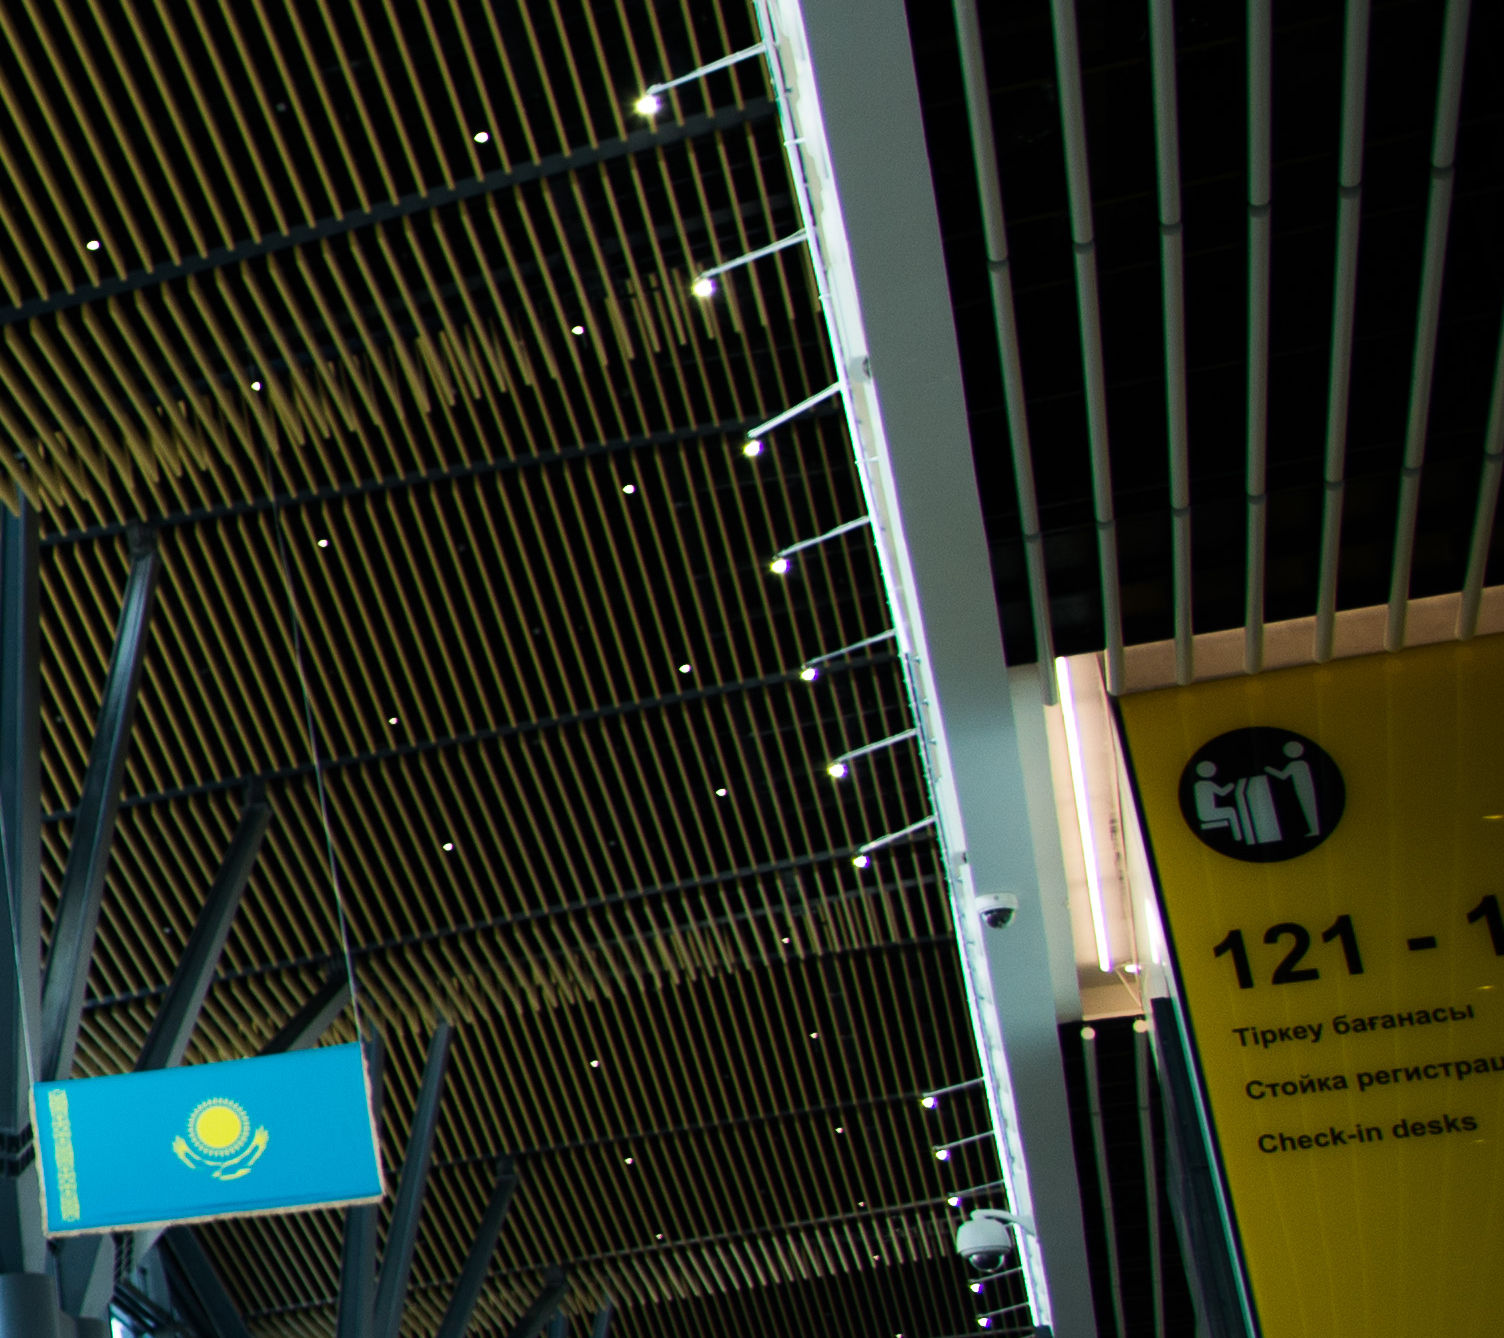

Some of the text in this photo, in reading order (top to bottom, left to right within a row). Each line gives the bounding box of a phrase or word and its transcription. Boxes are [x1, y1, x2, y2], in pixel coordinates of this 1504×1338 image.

[1213, 914, 1365, 990] 121
[1232, 1004, 1475, 1049] Тіркеу бағанасы
[1245, 1073, 1349, 1101] Стойка
[1257, 1113, 1478, 1154] Check-in desks
